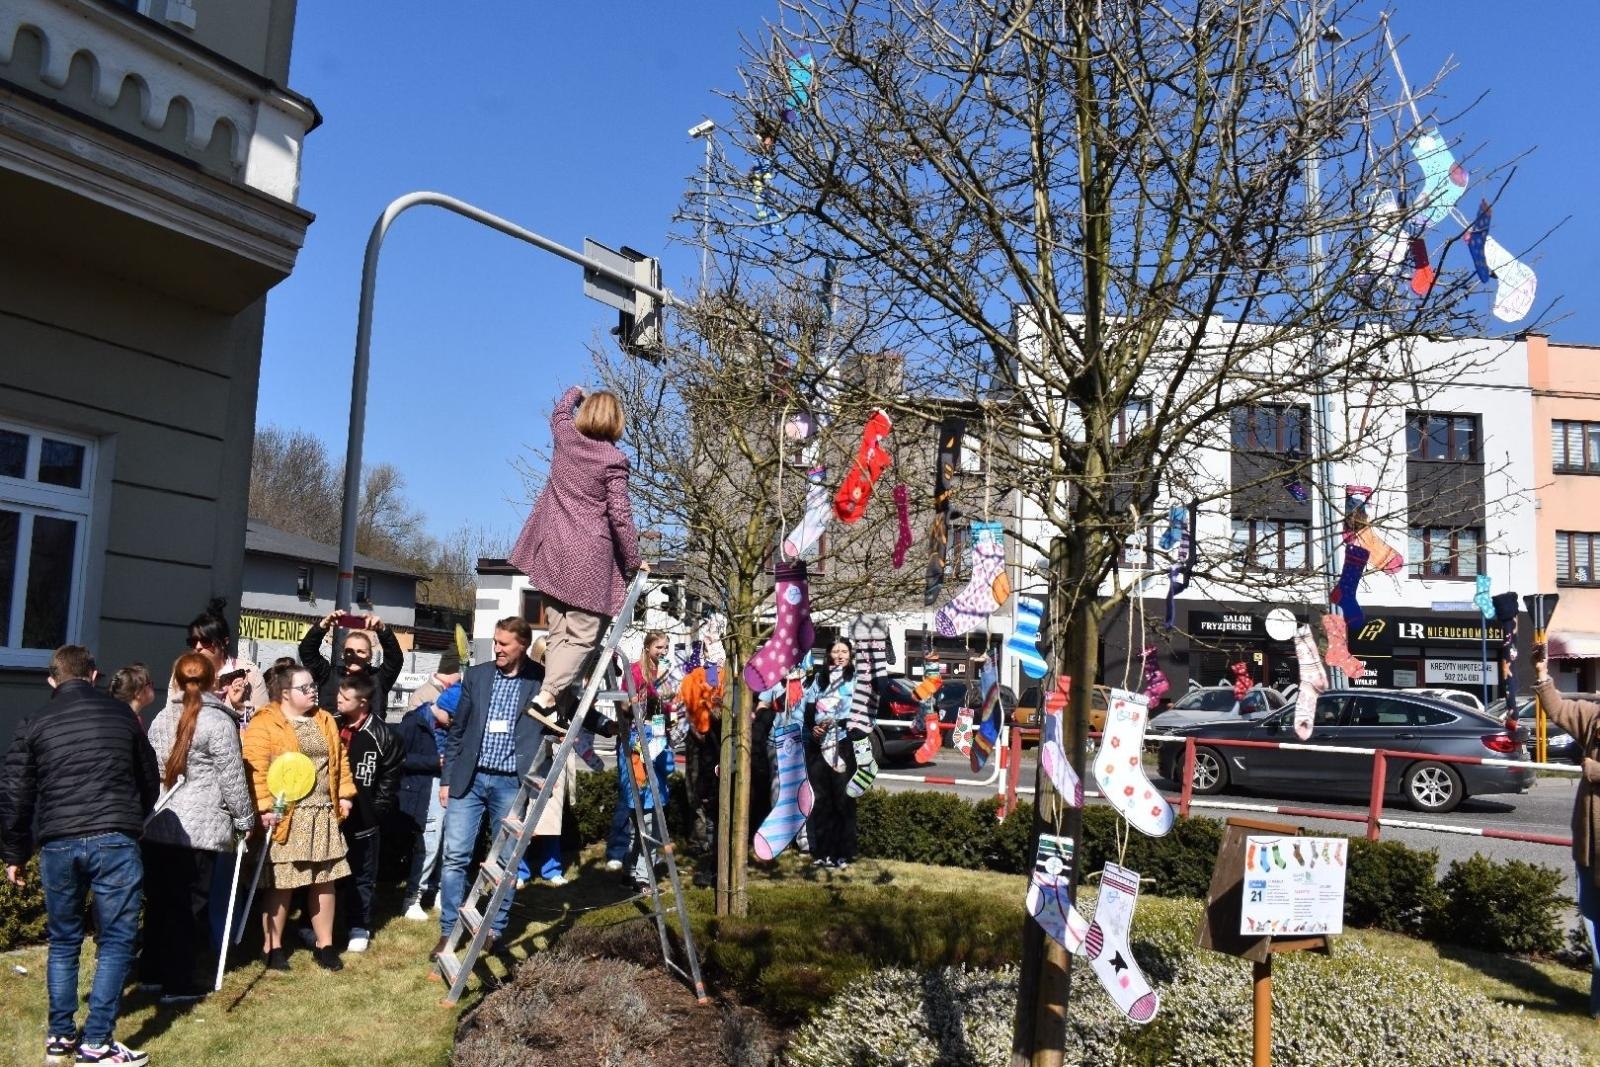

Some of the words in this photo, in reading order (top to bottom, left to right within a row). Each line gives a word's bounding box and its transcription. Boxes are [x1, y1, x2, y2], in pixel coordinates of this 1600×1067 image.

[1223, 615, 1252, 623] SALON
[1201, 622, 1252, 632] FRYZJERSKI
[1430, 662, 1457, 671] KREDYTY
[1250, 890, 1262, 902] 21
